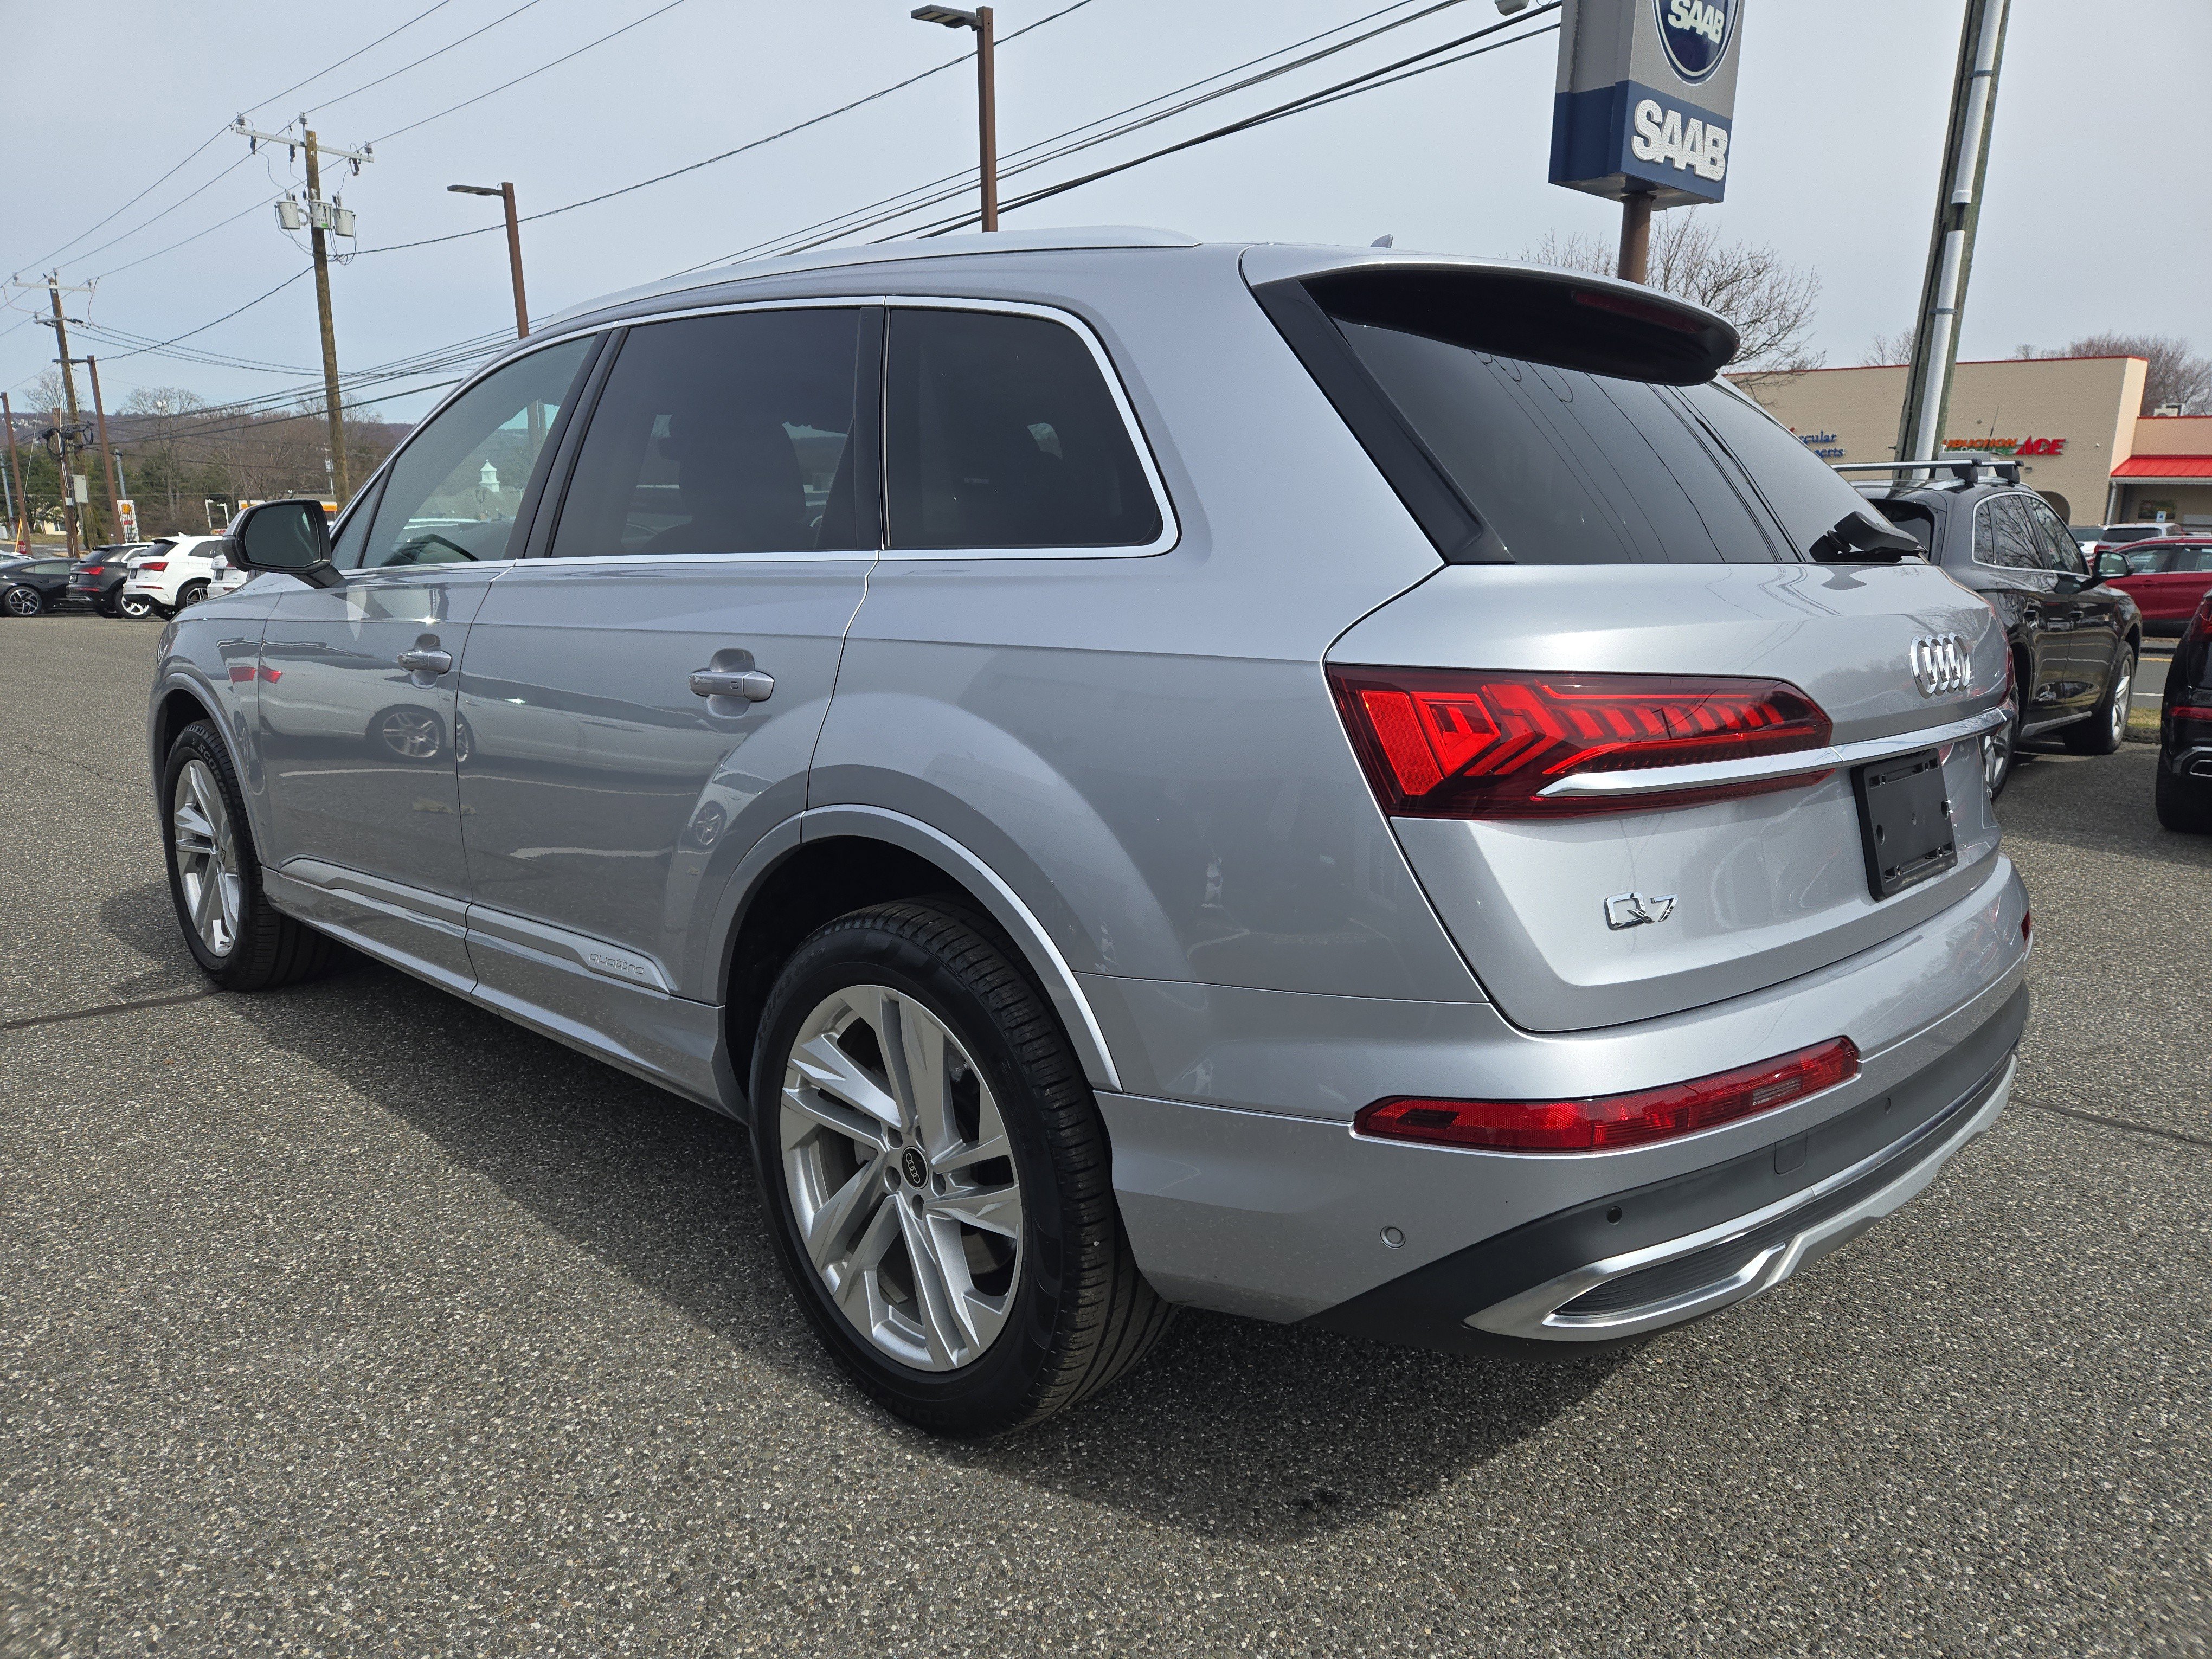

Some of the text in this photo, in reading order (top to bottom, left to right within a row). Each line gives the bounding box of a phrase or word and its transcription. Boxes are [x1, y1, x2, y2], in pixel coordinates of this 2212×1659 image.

[1668, 0, 1725, 44] SAAB
[1631, 99, 1728, 181] SAAB
[1943, 438, 2018, 448] UBUCHON
[2016, 435, 2066, 455] ACE
[1604, 892, 1679, 931] Q7
[589, 953, 645, 975] quattro
